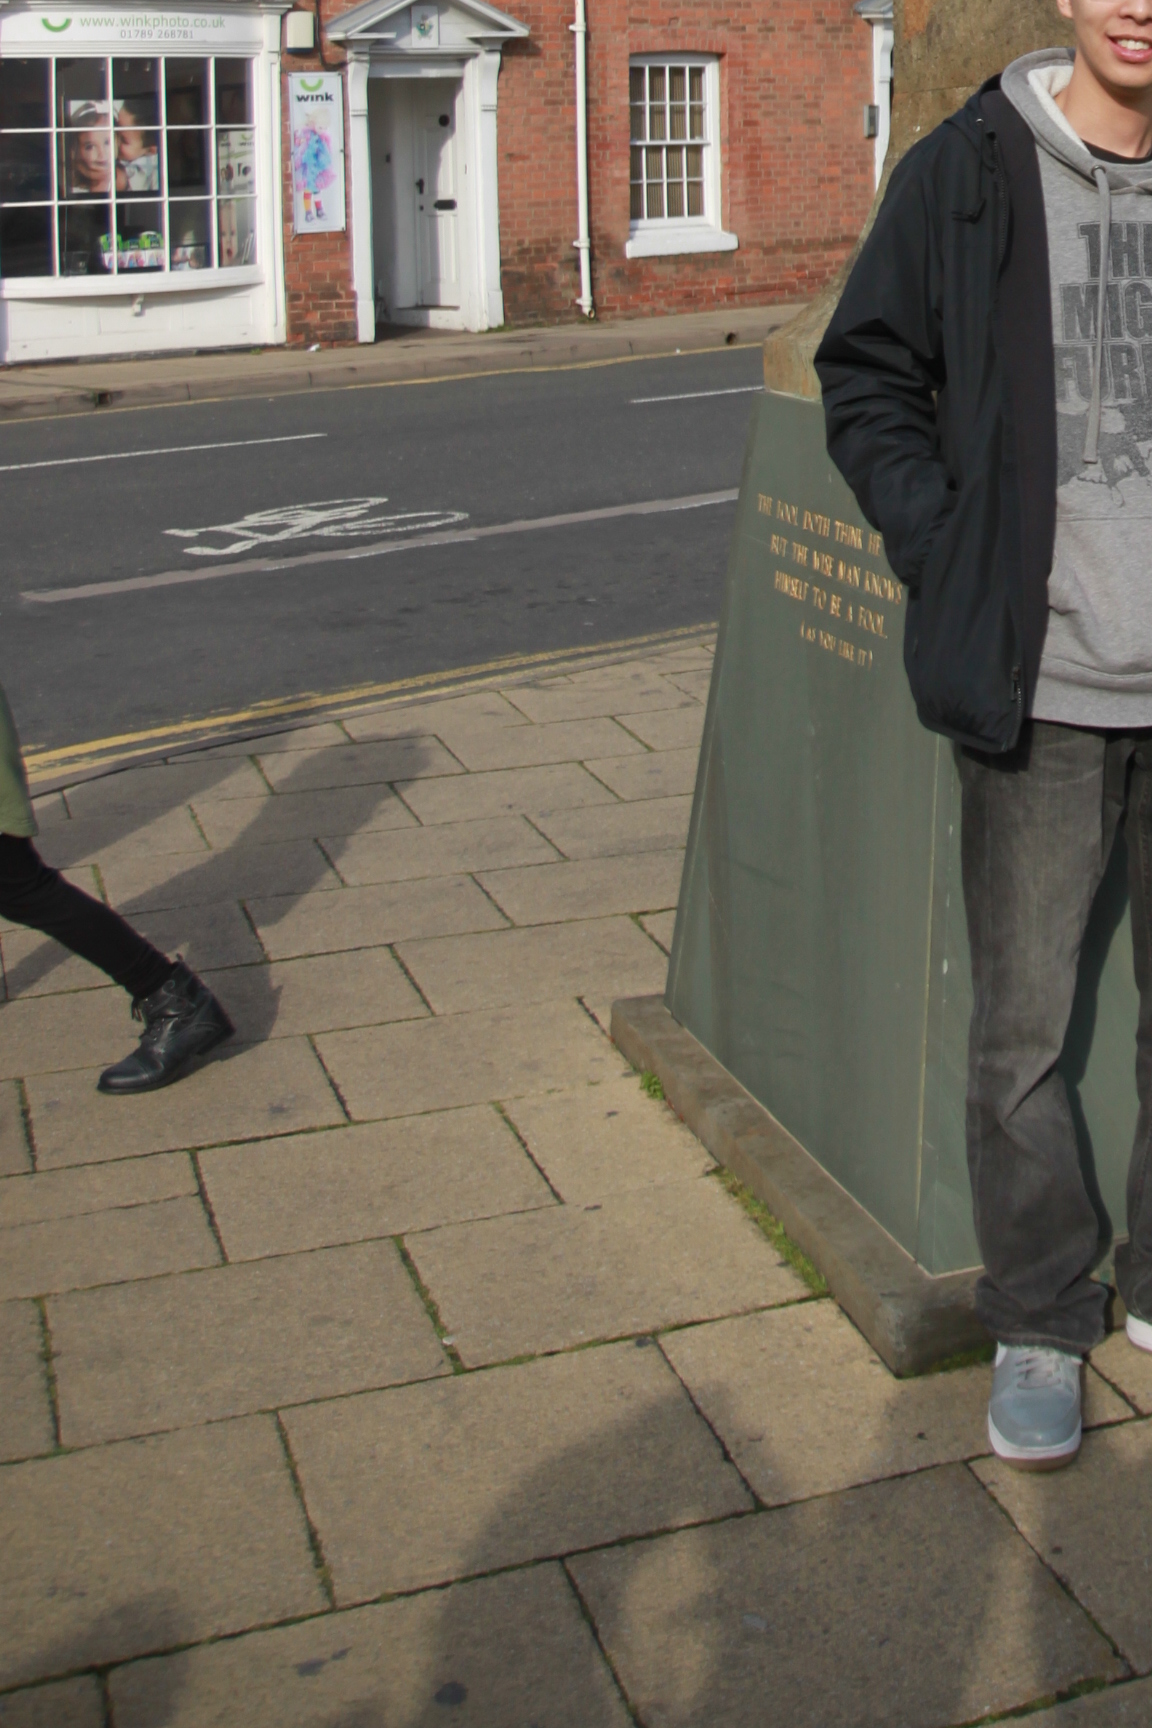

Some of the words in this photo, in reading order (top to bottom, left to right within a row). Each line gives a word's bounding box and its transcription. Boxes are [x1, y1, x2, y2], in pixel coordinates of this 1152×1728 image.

[80, 14, 227, 30] www.winkphoto.co.uk
[120, 29, 153, 39] 01789
[157, 29, 195, 39] 268781
[296, 92, 335, 103] wink
[758, 493, 773, 517] THE
[834, 520, 864, 550] THINK
[867, 532, 882, 556] HE
[770, 533, 788, 558] BUT
[792, 541, 809, 567] THE
[812, 549, 834, 577] WISE
[837, 559, 861, 587] MAN
[864, 570, 903, 605] KNOWS
[774, 570, 809, 602] HIMSELF
[812, 585, 827, 610] TO
[830, 594, 842, 618] BE
[819, 629, 836, 652] YOU
[838, 639, 855, 662] LIKE
